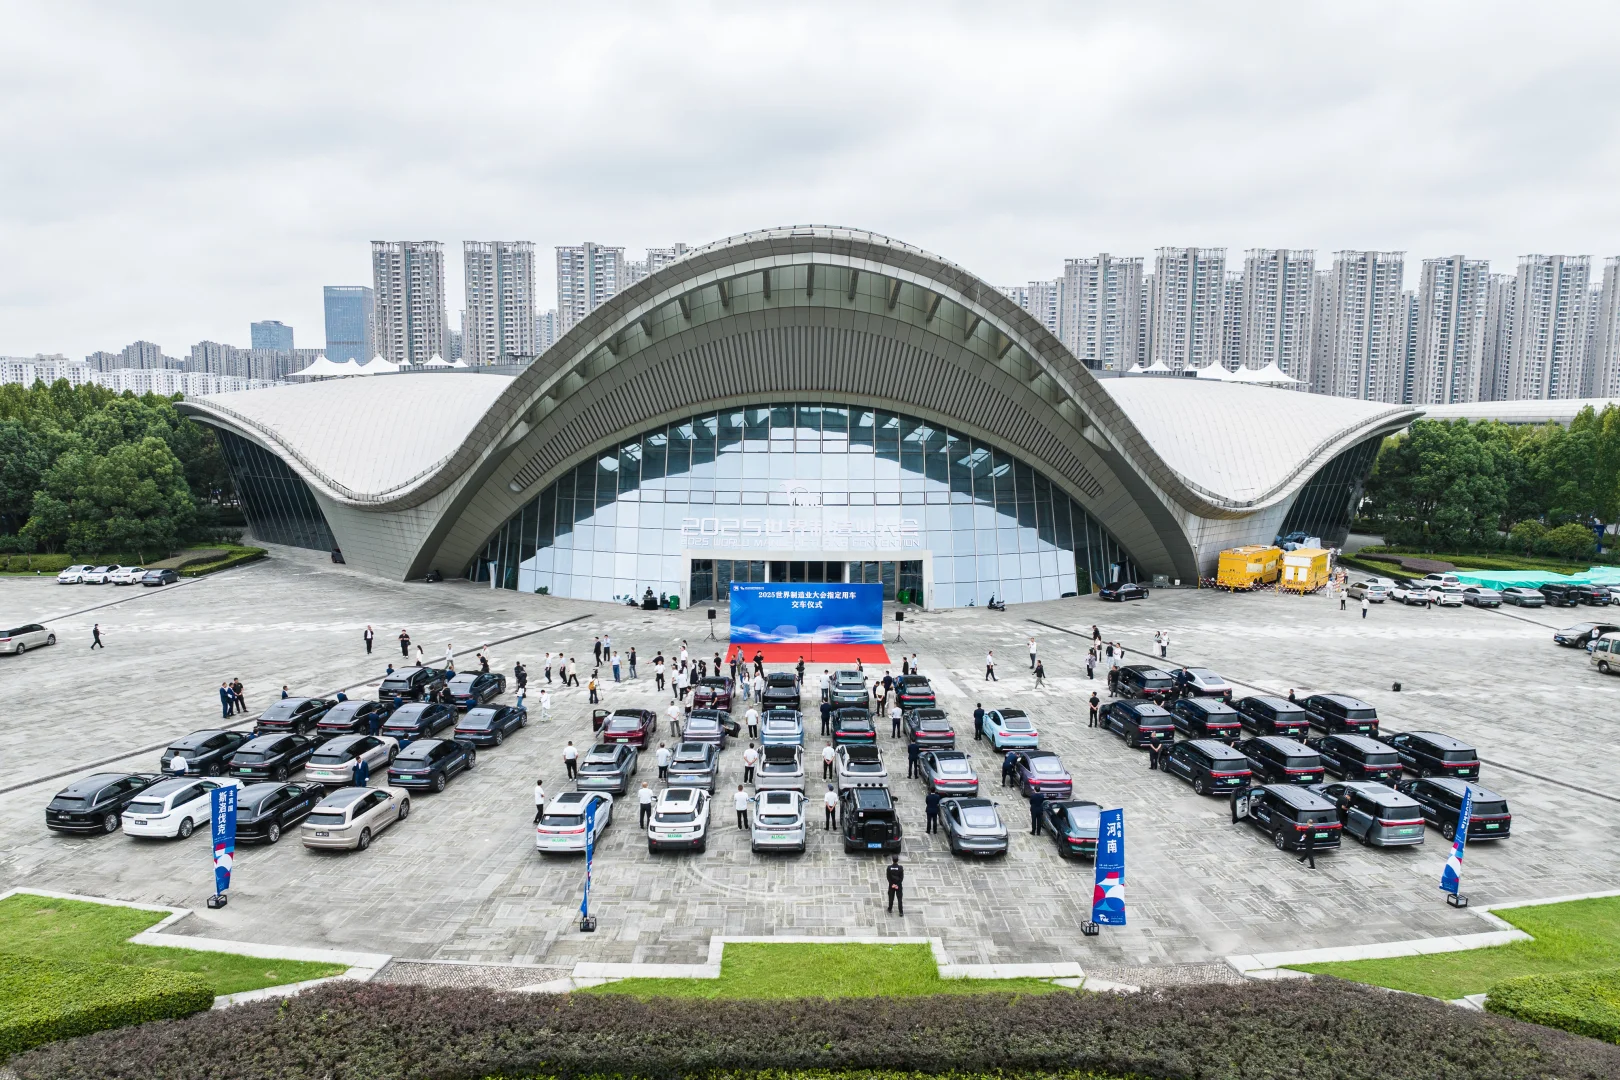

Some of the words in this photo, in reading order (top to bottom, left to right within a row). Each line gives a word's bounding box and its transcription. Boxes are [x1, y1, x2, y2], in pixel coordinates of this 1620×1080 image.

[681, 537, 709, 546] 2025
[713, 537, 750, 547] WORLD
[852, 538, 920, 547] CONVENTION
[758, 590, 857, 600] 2025世界制造业大会指定用车
[791, 600, 823, 609] 交车仪式
[217, 791, 227, 836] 斯洛伐克
[1107, 822, 1117, 853] 河南
